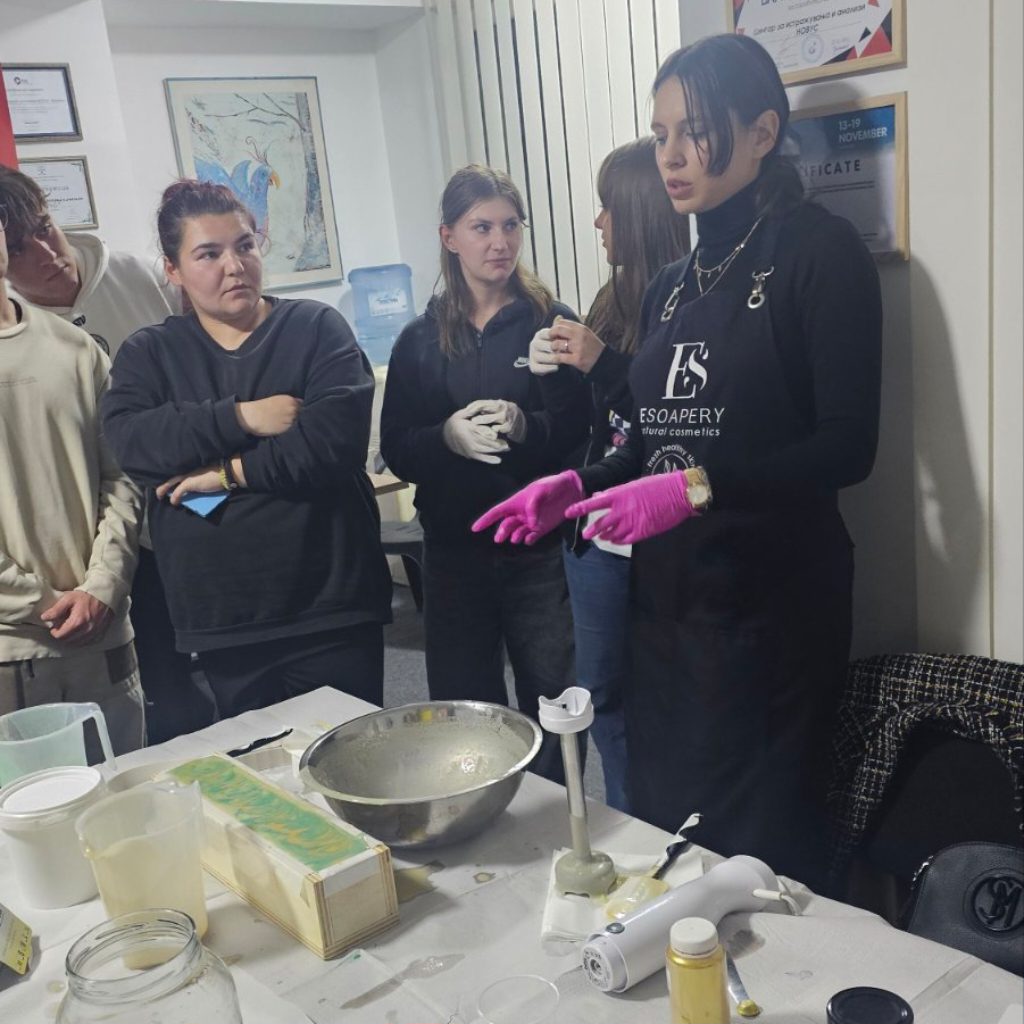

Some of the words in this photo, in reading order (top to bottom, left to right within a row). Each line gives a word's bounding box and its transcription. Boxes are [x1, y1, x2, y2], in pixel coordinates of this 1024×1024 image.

[838, 118, 861, 131] 13-19
[838, 127, 888, 143] NOVEMBER
[804, 159, 861, 177] IFICATE
[639, 407, 726, 424] ESOAPERY
[642, 427, 667, 436] tural
[669, 427, 720, 437] cosmetics
